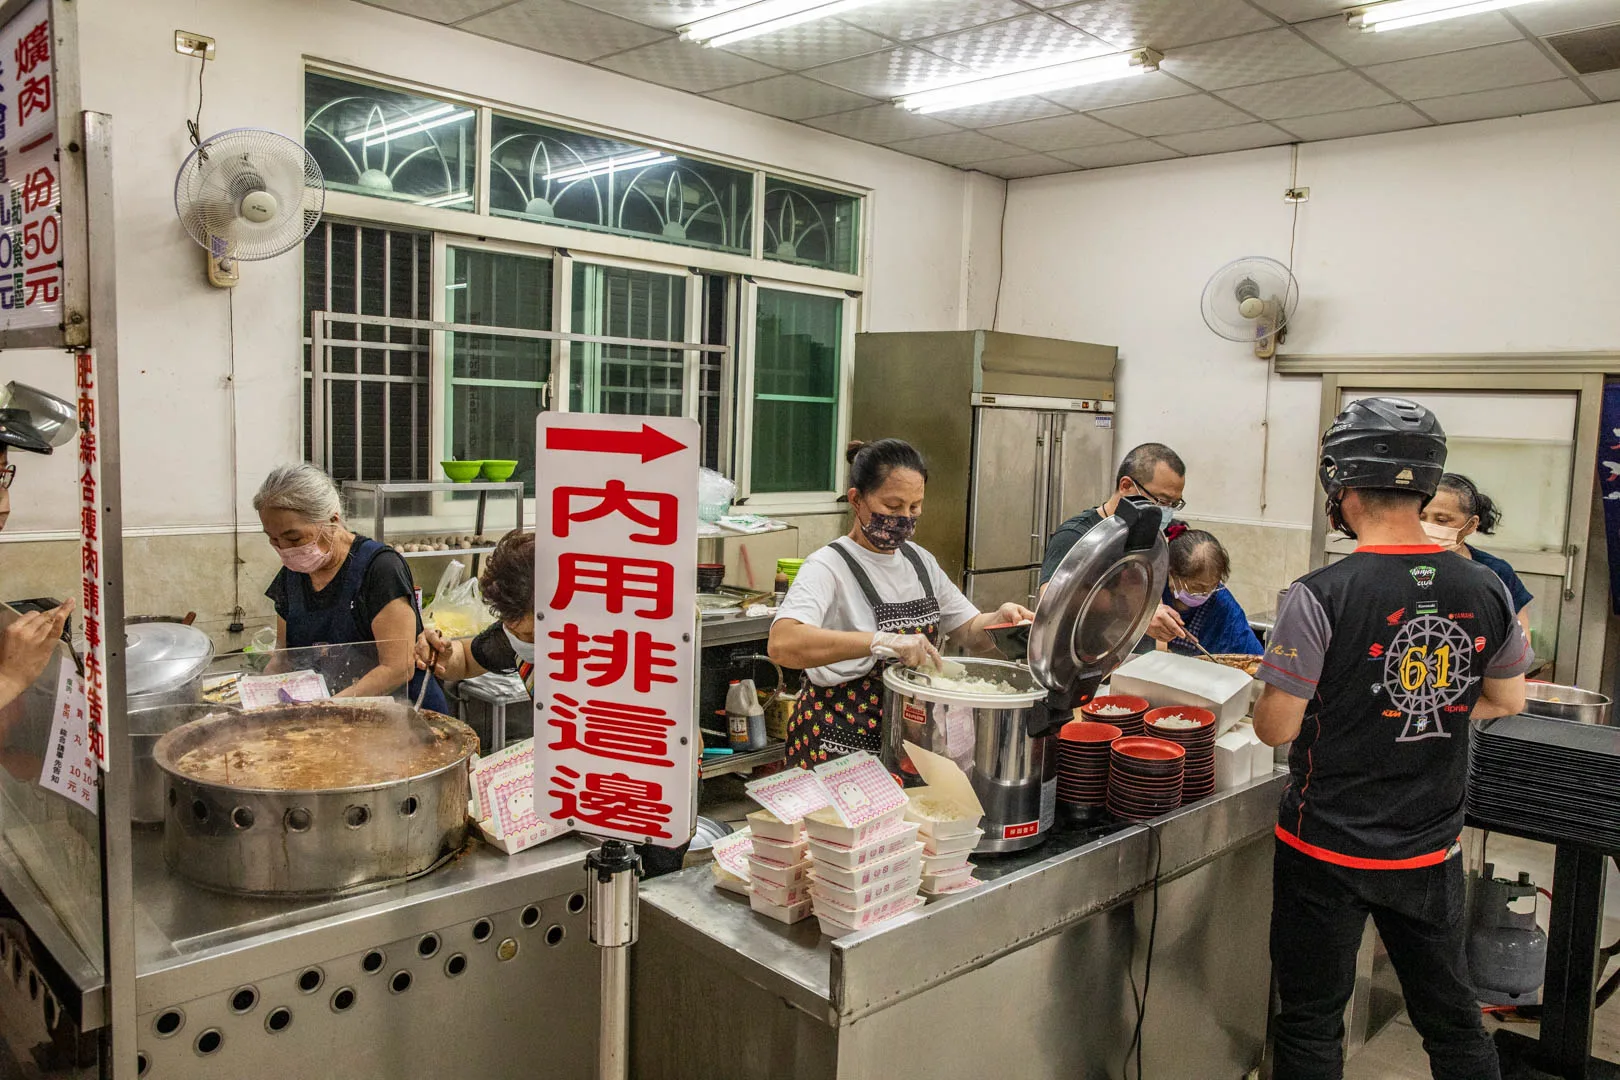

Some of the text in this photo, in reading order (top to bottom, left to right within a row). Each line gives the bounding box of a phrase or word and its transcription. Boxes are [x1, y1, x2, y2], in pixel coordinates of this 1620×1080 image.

[547, 480, 679, 839] 內用排這邊
[1399, 644, 1451, 691] 61
[1381, 710, 1402, 718] KTM
[1443, 703, 1469, 713] aprilia
